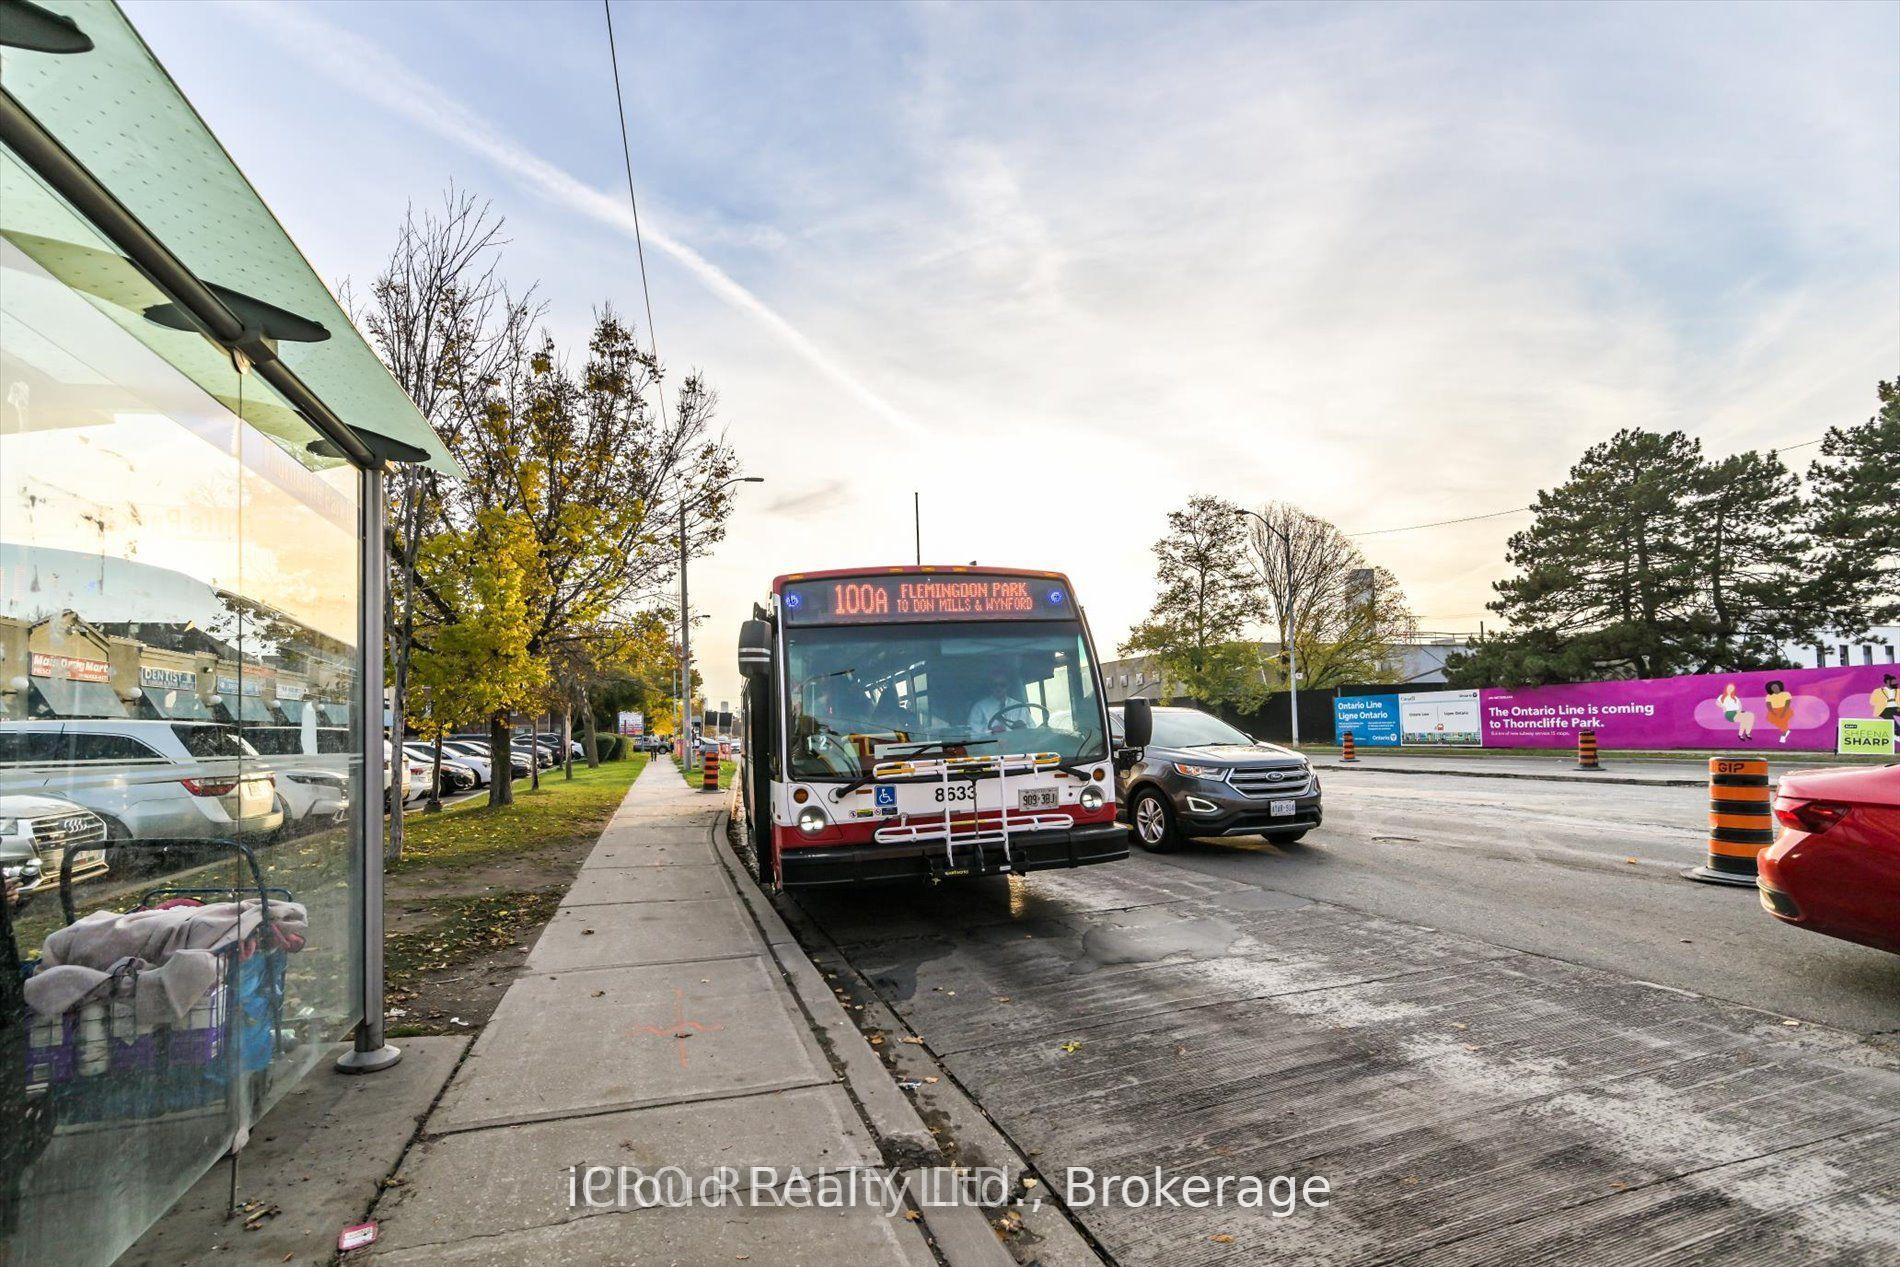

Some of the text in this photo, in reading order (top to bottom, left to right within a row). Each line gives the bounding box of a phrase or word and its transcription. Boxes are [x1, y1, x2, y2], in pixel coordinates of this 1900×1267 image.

[900, 582, 1028, 598] FLEMINGDON PARK
[835, 584, 888, 614] 100A
[913, 599, 935, 612] DON
[939, 598, 971, 612] MILLS
[975, 599, 982, 612] &
[986, 597, 1032, 610] WYNFORD
[145, 669, 182, 682] DENTIST
[1338, 701, 1383, 710] Ontario Line
[1488, 702, 1654, 717] The Ontario Line is coming
[1338, 710, 1388, 721] Ligne Ontario
[1489, 717, 1605, 729] to Thorncliffe Park.
[1844, 730, 1889, 739] SHEENA
[1844, 737, 1890, 746] SHARP
[1718, 763, 1745, 773] GIP
[934, 786, 977, 802] 8633
